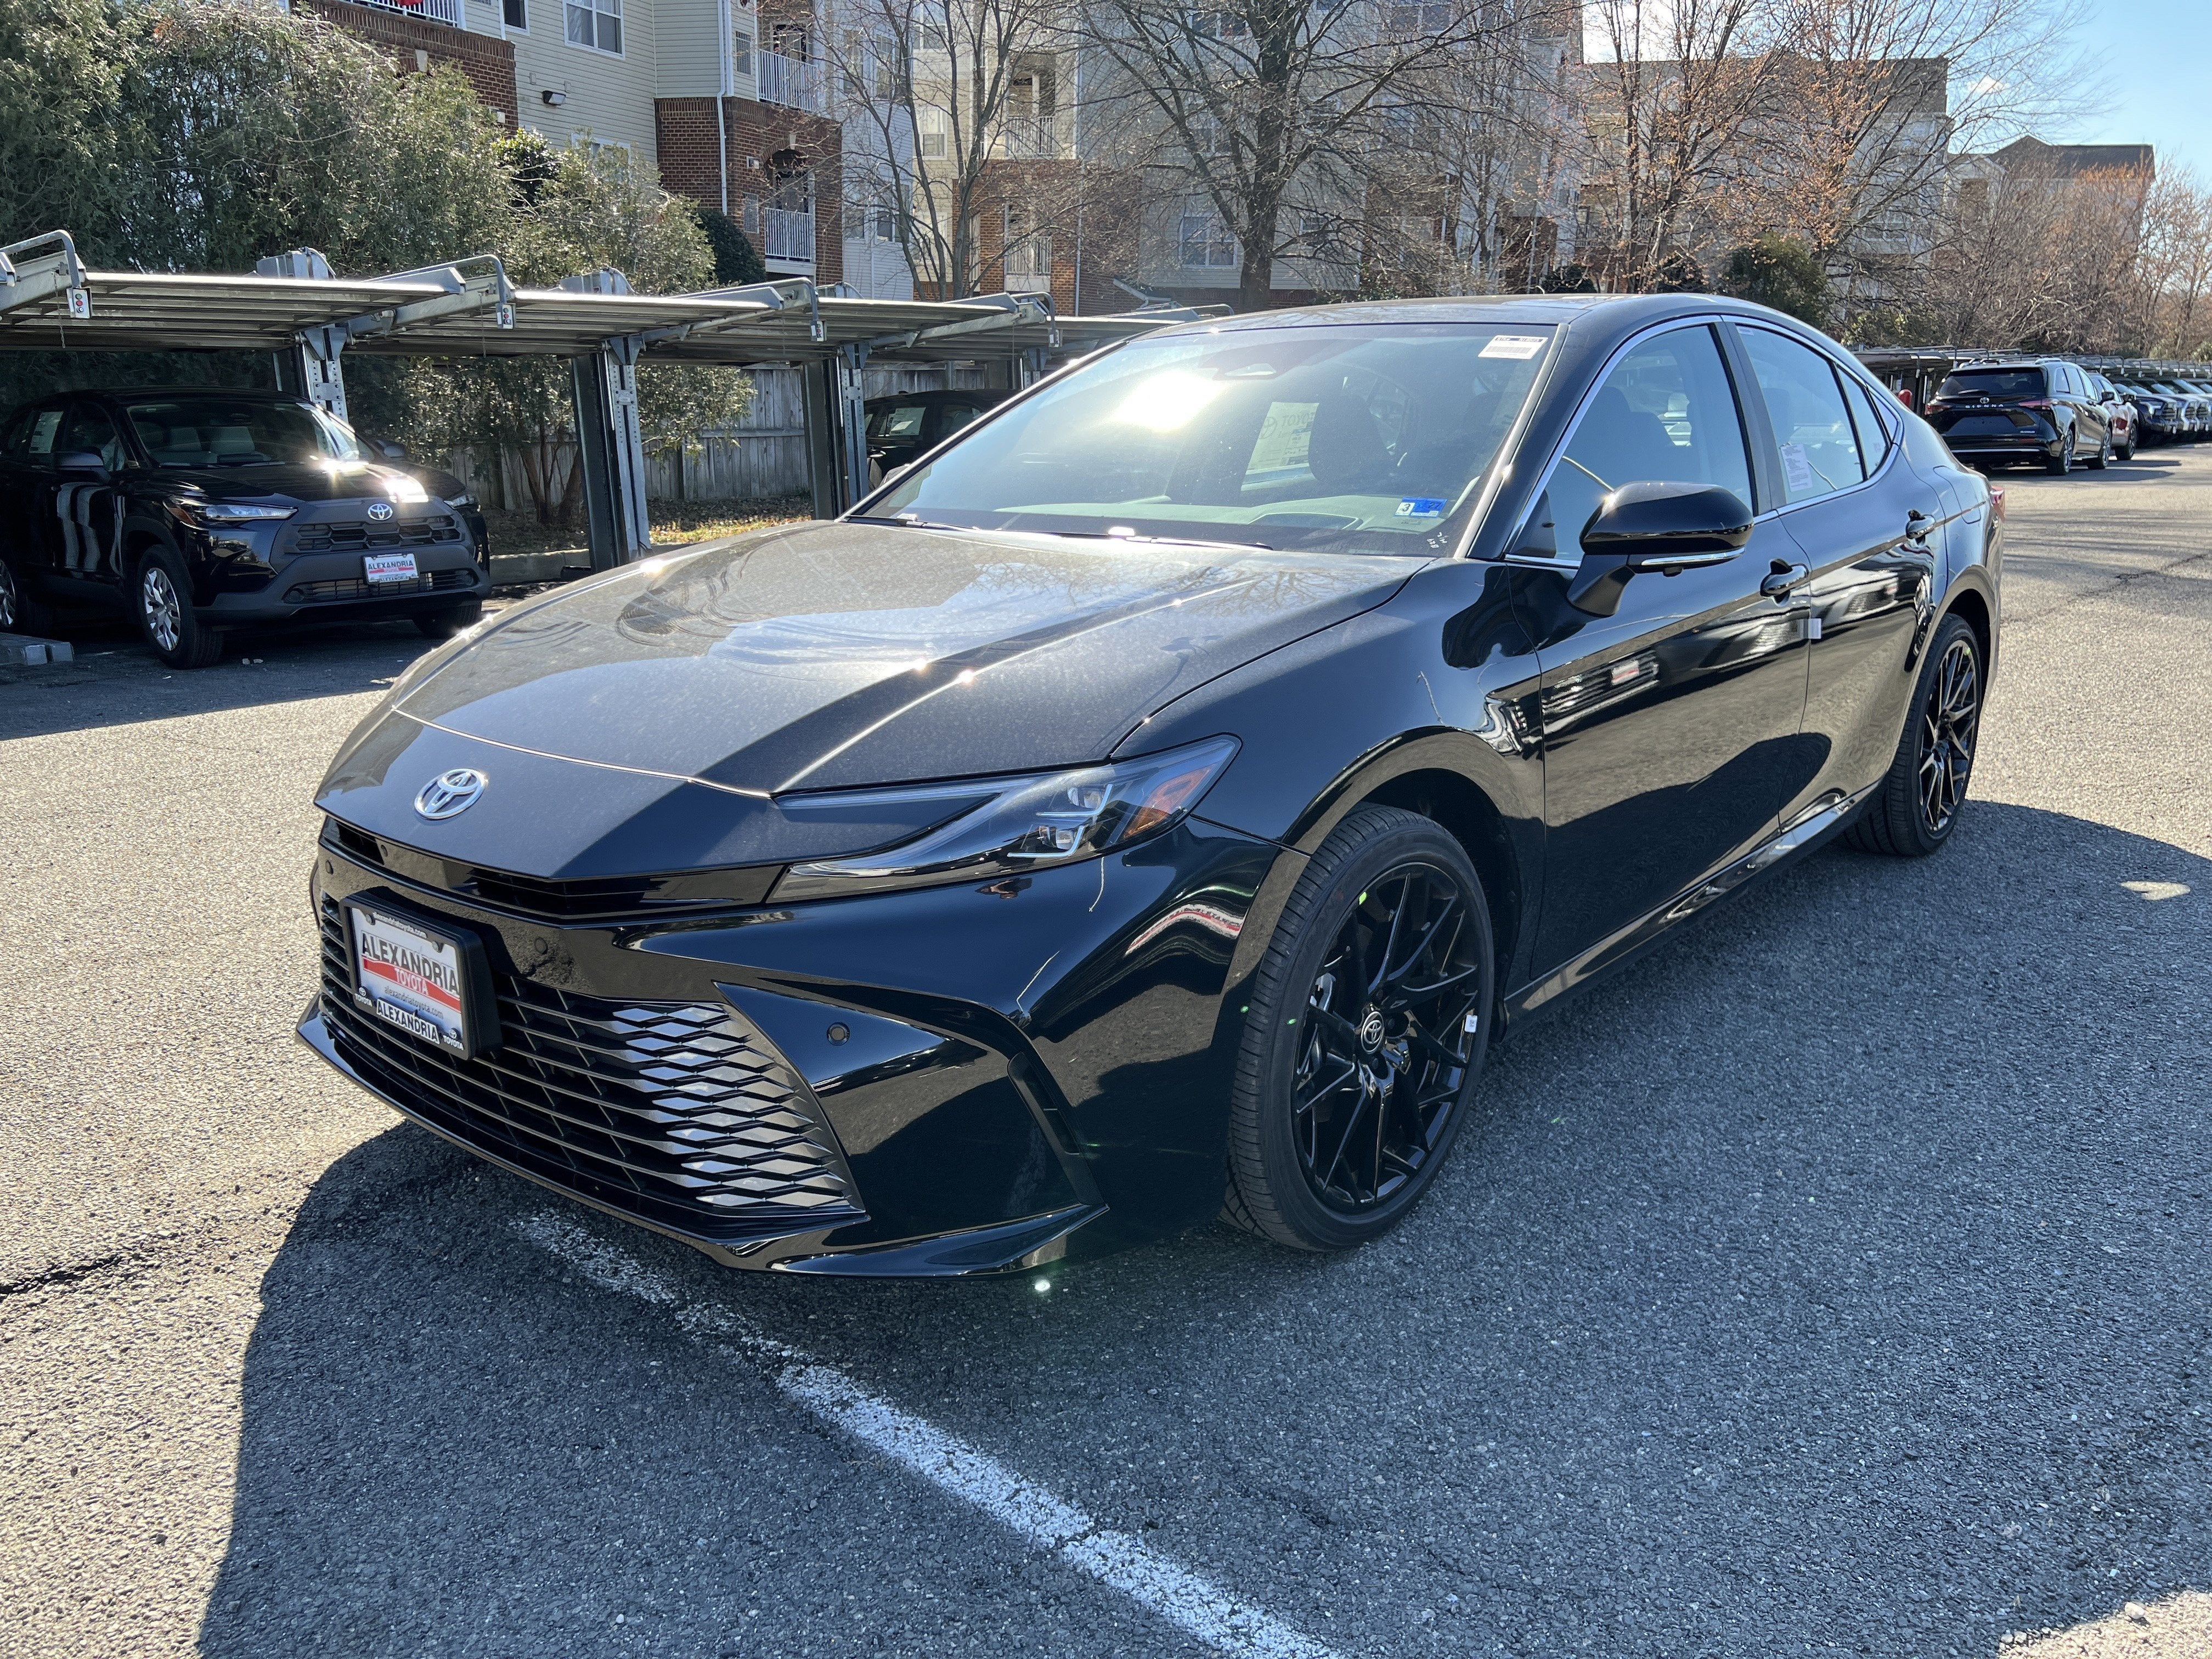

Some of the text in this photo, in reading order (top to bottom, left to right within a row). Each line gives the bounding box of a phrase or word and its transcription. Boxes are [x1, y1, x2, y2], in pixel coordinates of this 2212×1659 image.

[1402, 503, 1411, 512] 3
[1427, 501, 1442, 510] 27
[368, 560, 413, 569] ALEXANDRIA
[362, 933, 459, 995] ALEXANDRIA
[394, 968, 428, 995] TOYOTA
[354, 993, 373, 1007] TOYOTA
[385, 986, 443, 1019] alexandriatoyota.com
[376, 998, 440, 1044] ALEXANDRIA
[443, 1035, 464, 1051] TOYOTA
